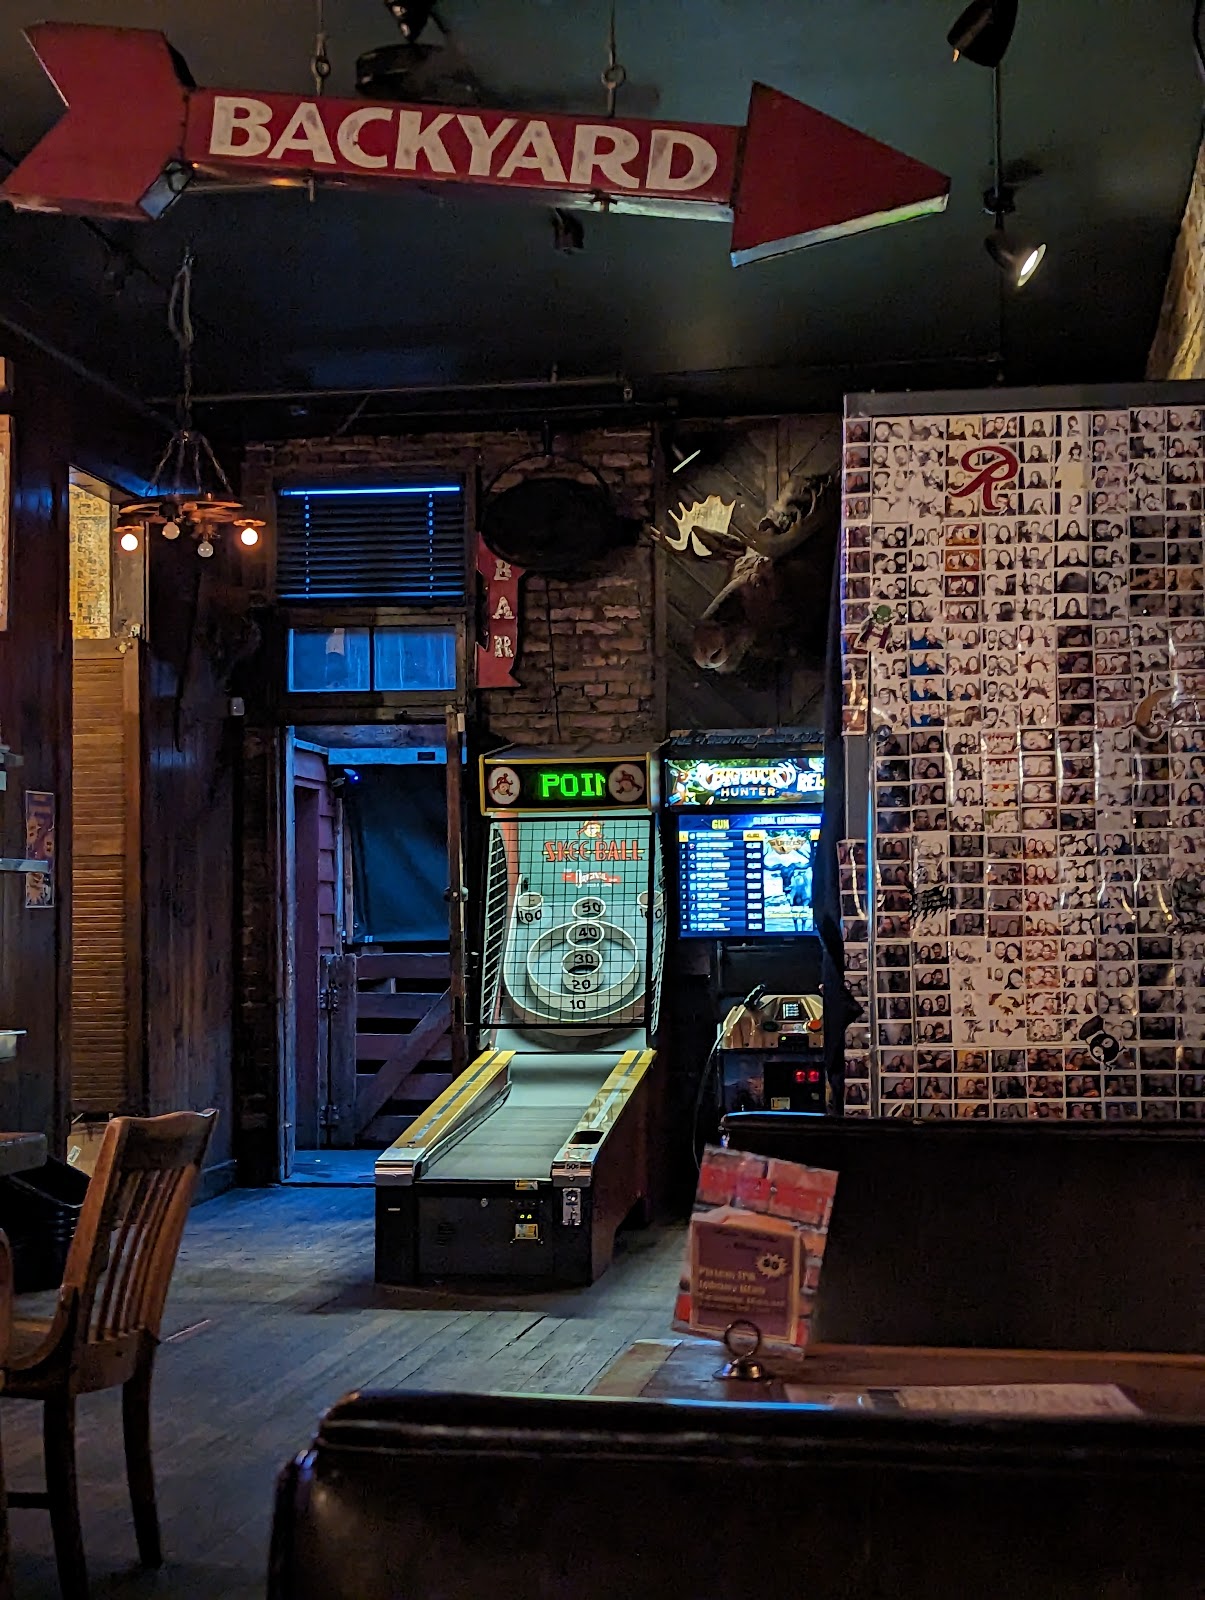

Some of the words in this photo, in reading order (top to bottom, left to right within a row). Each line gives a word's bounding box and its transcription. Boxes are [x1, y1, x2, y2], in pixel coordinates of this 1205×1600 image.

[208, 96, 718, 191] BACKYARD
[491, 558, 515, 658] BAR
[720, 787, 776, 797] HUNTER
[582, 901, 601, 913] 50
[519, 909, 542, 923] 100
[578, 927, 598, 938] 40
[574, 953, 594, 964] 30
[571, 979, 591, 990] 20
[569, 999, 586, 1010] 10
